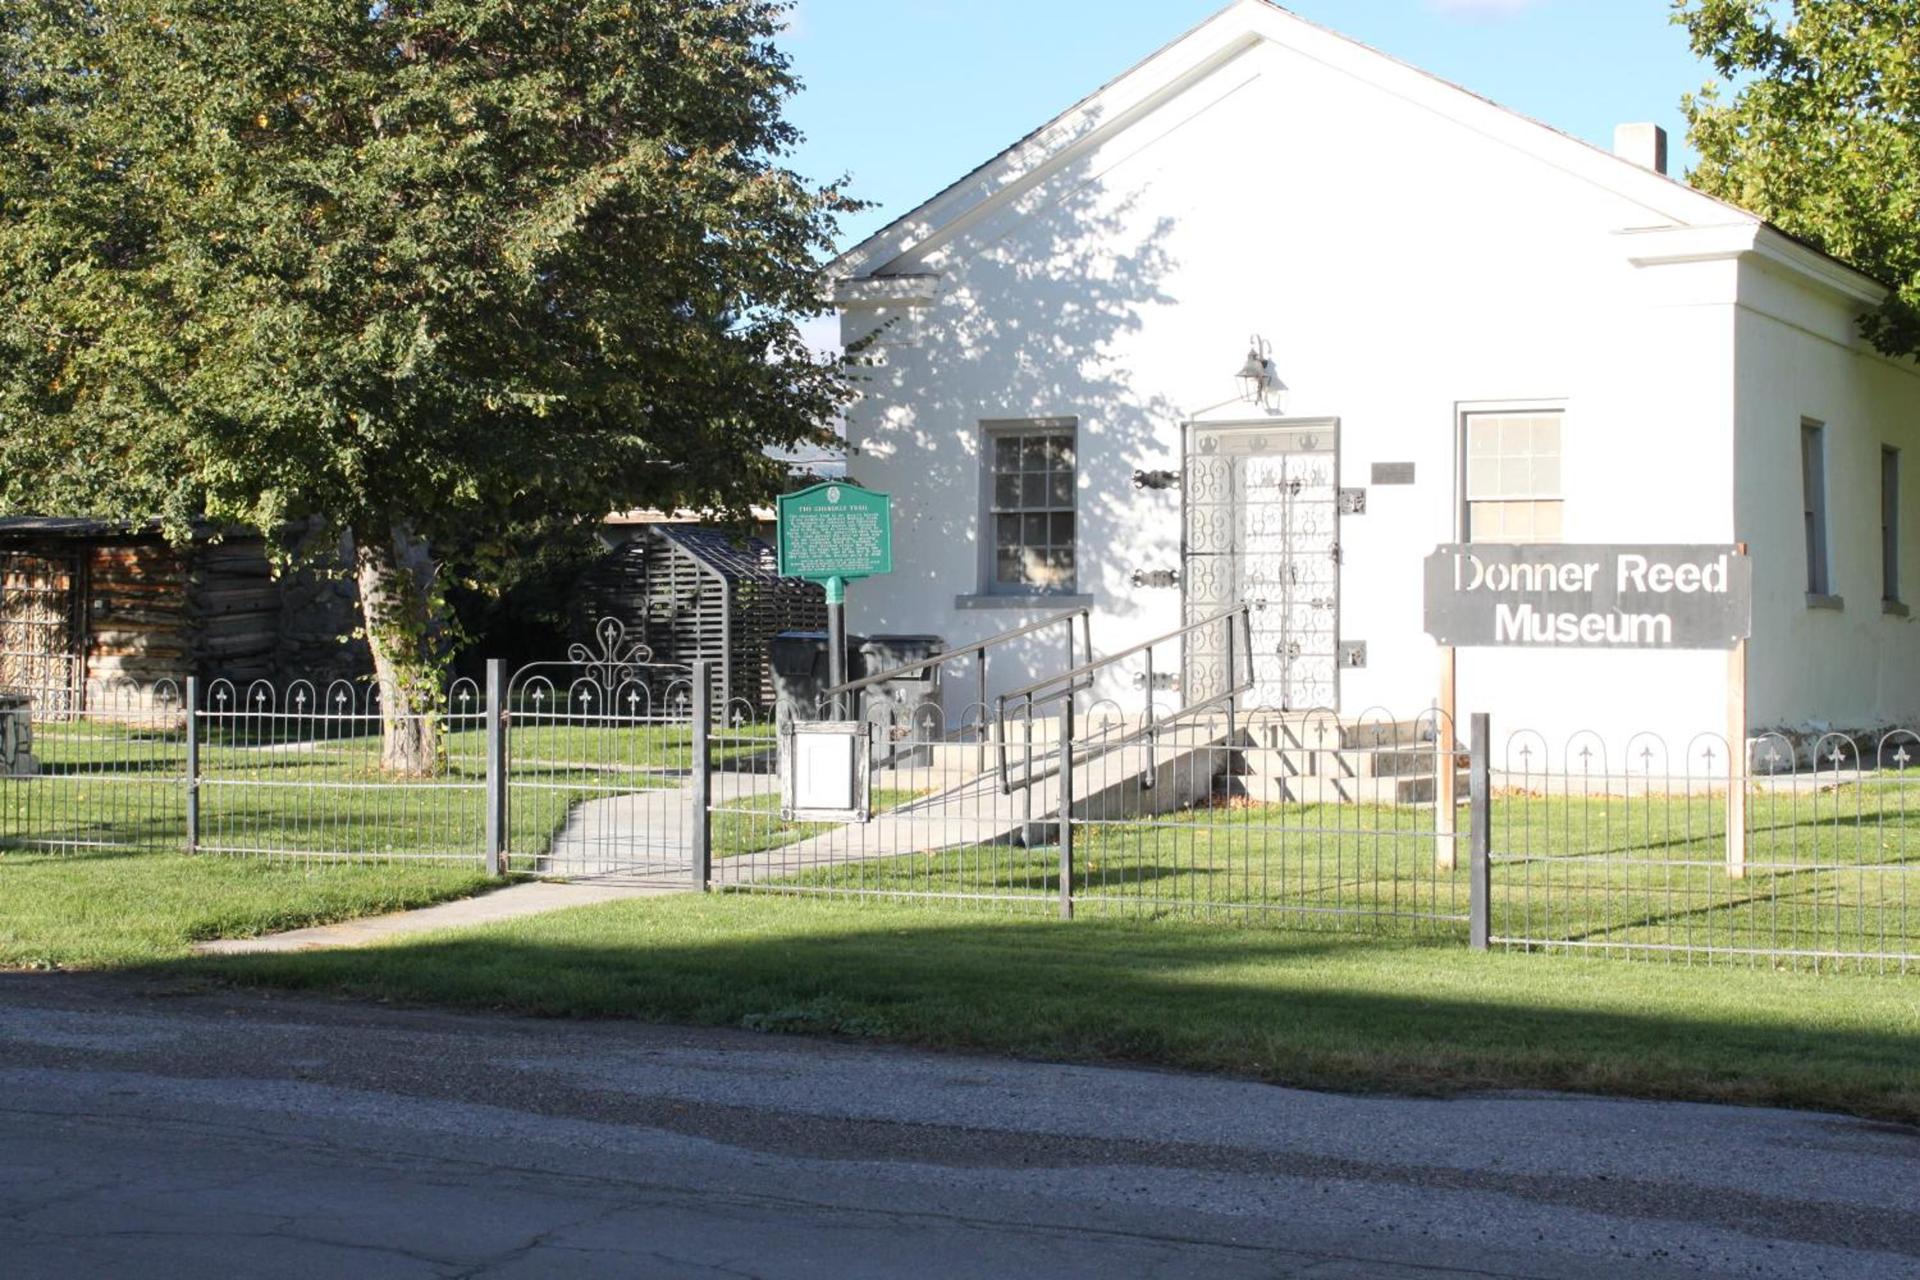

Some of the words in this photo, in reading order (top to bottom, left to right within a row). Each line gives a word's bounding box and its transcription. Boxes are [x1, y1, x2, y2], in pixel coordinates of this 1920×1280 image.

[1454, 554, 1600, 592] Donner
[1617, 554, 1728, 592] Reed
[1494, 603, 1672, 642] Museum
